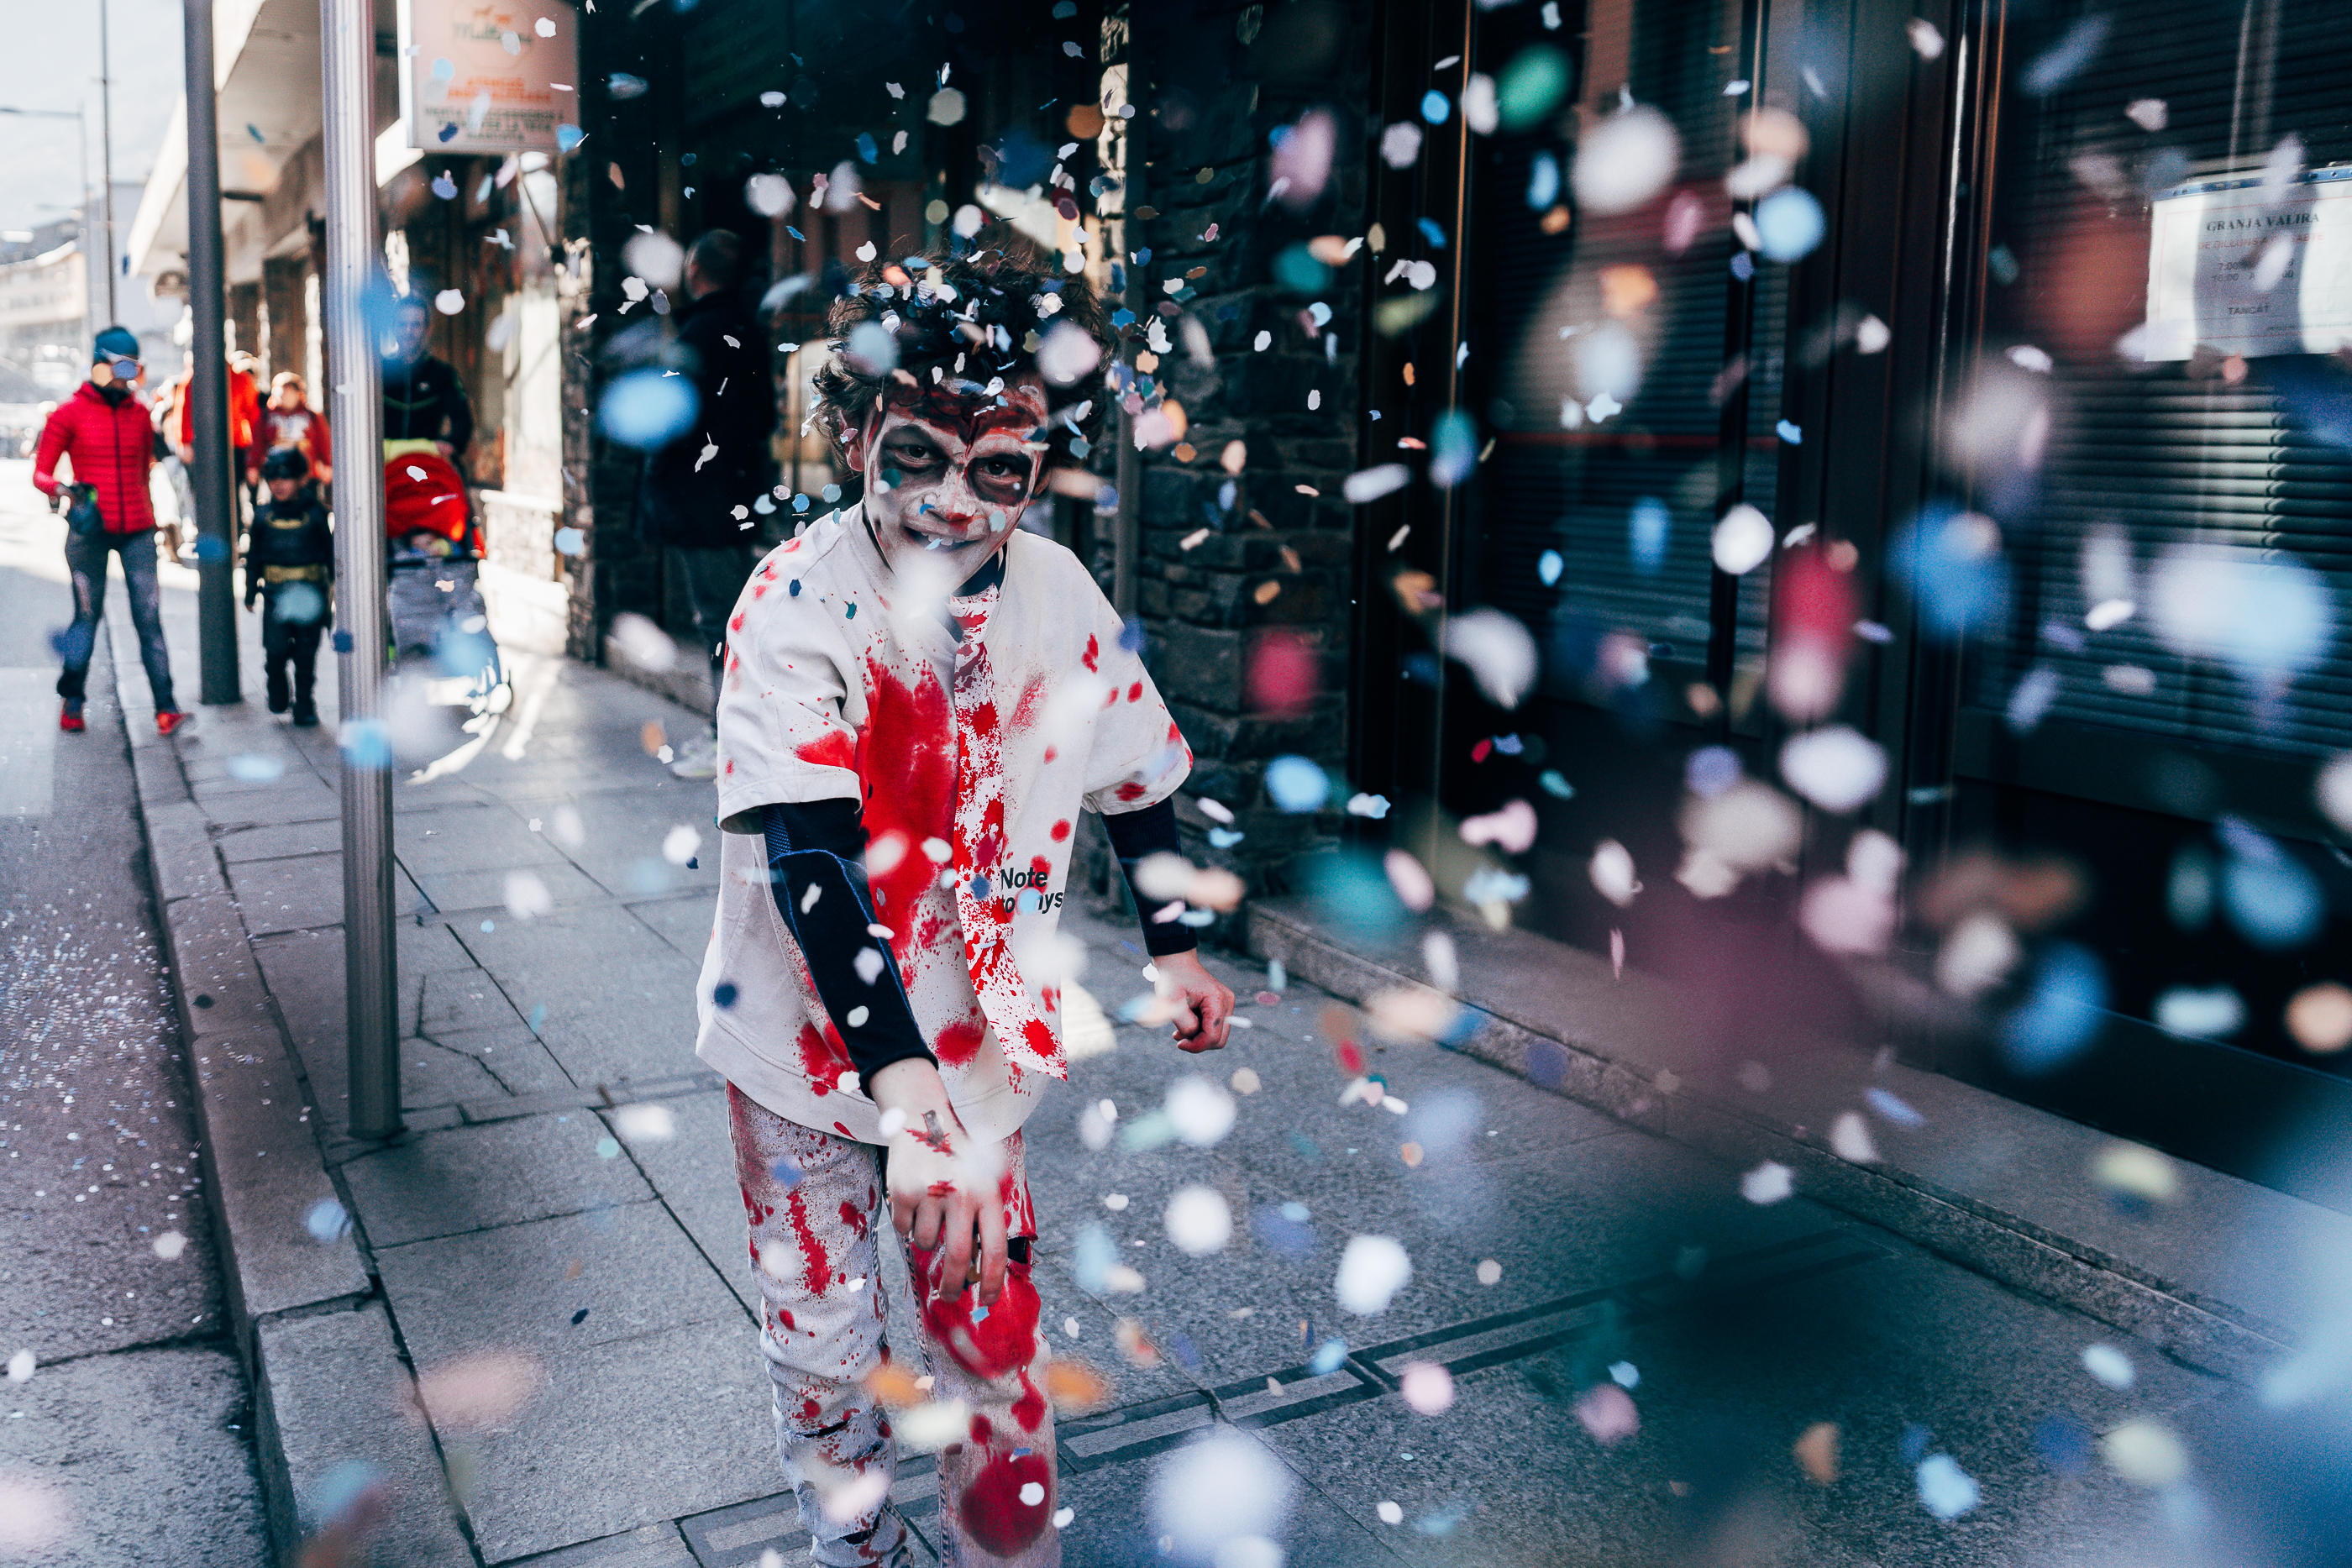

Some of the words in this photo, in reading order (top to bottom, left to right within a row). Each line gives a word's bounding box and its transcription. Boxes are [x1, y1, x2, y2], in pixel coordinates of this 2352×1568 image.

[2207, 218, 2261, 232] GRANJA
[2266, 212, 2319, 226] VALIRA
[1001, 867, 1048, 889] Note
